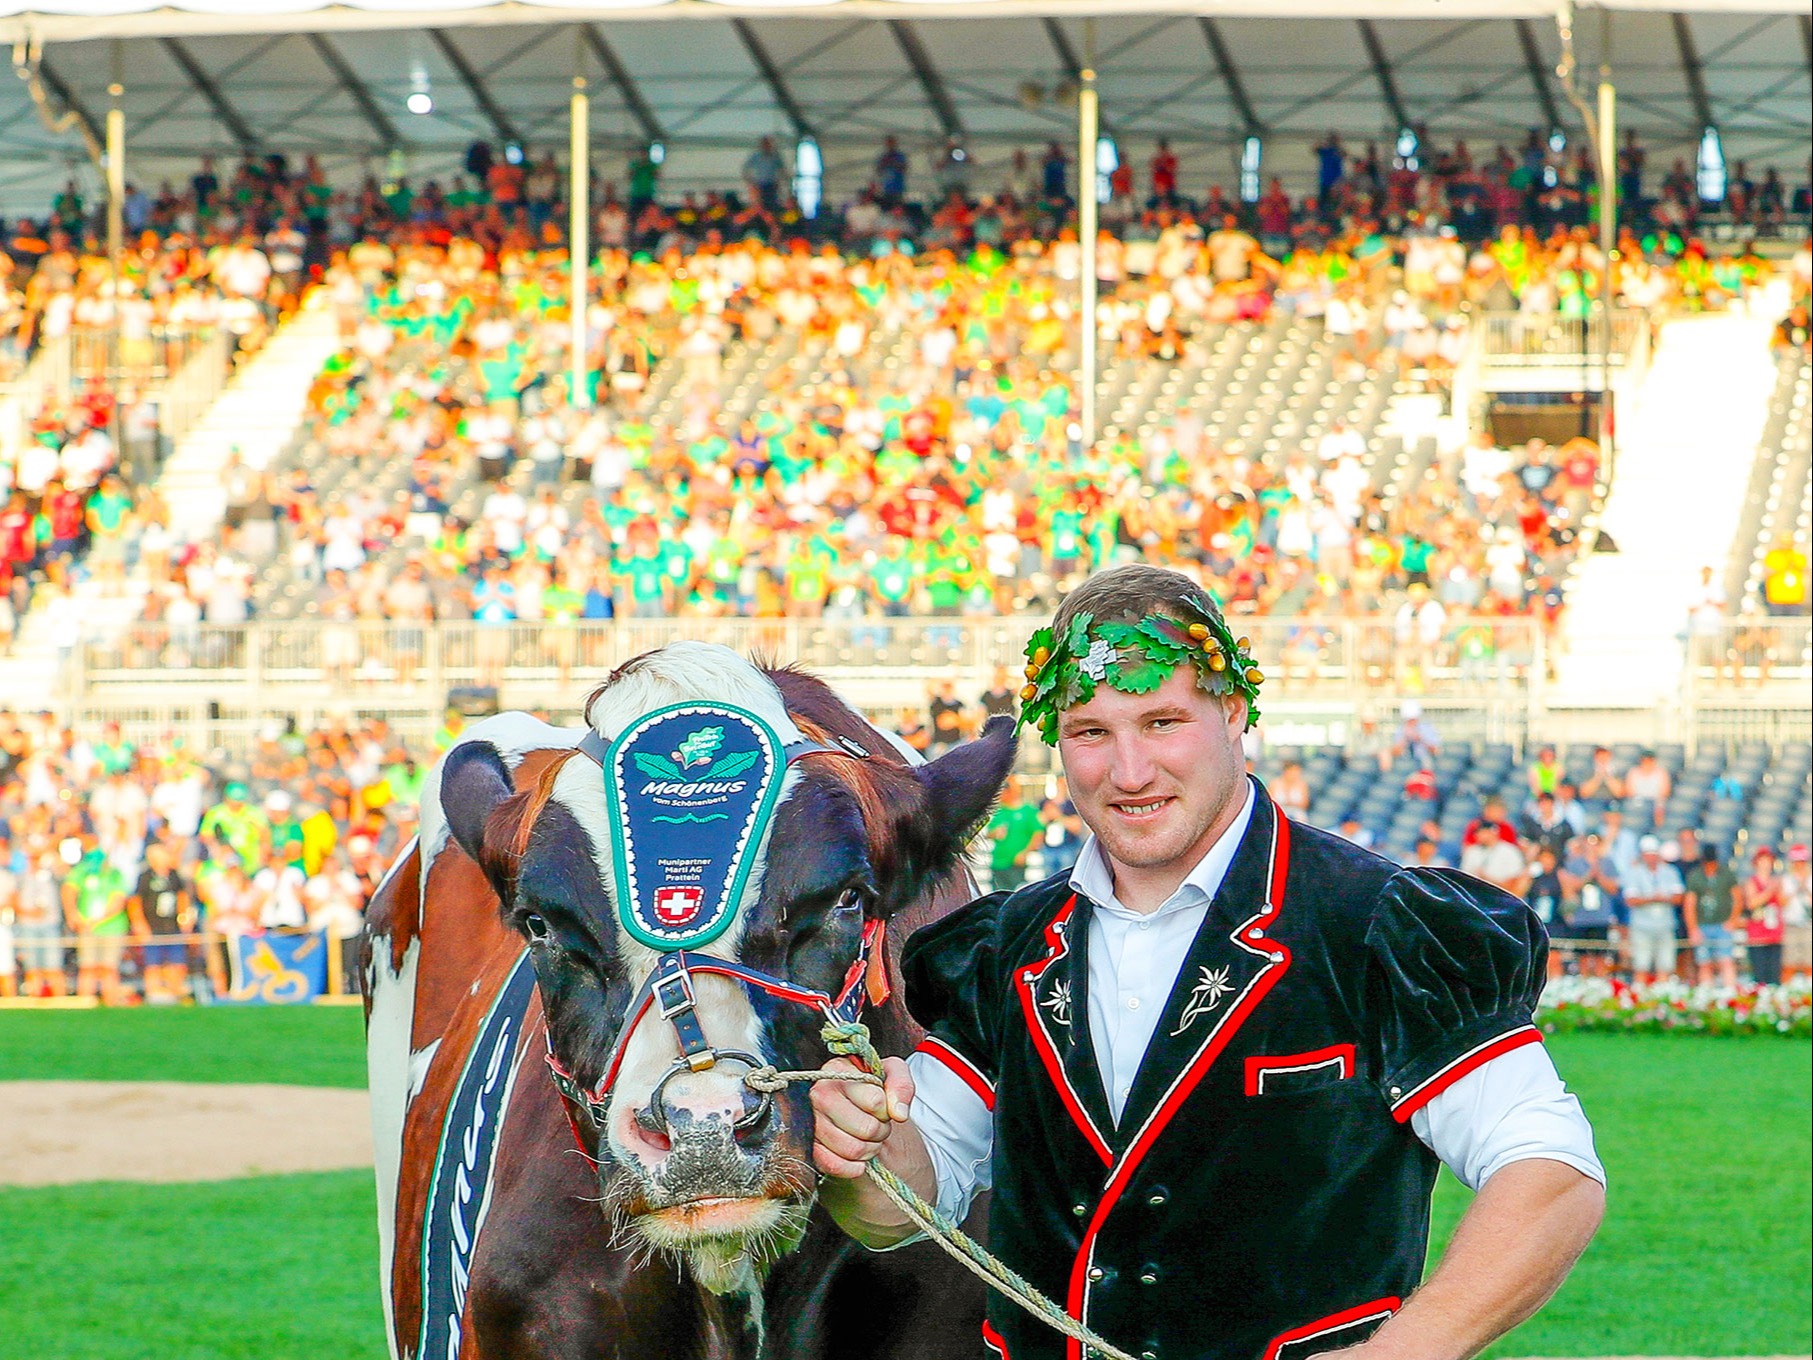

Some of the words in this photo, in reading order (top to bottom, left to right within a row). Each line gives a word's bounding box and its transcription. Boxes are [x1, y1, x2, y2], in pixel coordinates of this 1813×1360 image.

[640, 781, 747, 798] Magnus
[653, 797, 670, 805] vom
[671, 795, 728, 807] Schönenberg
